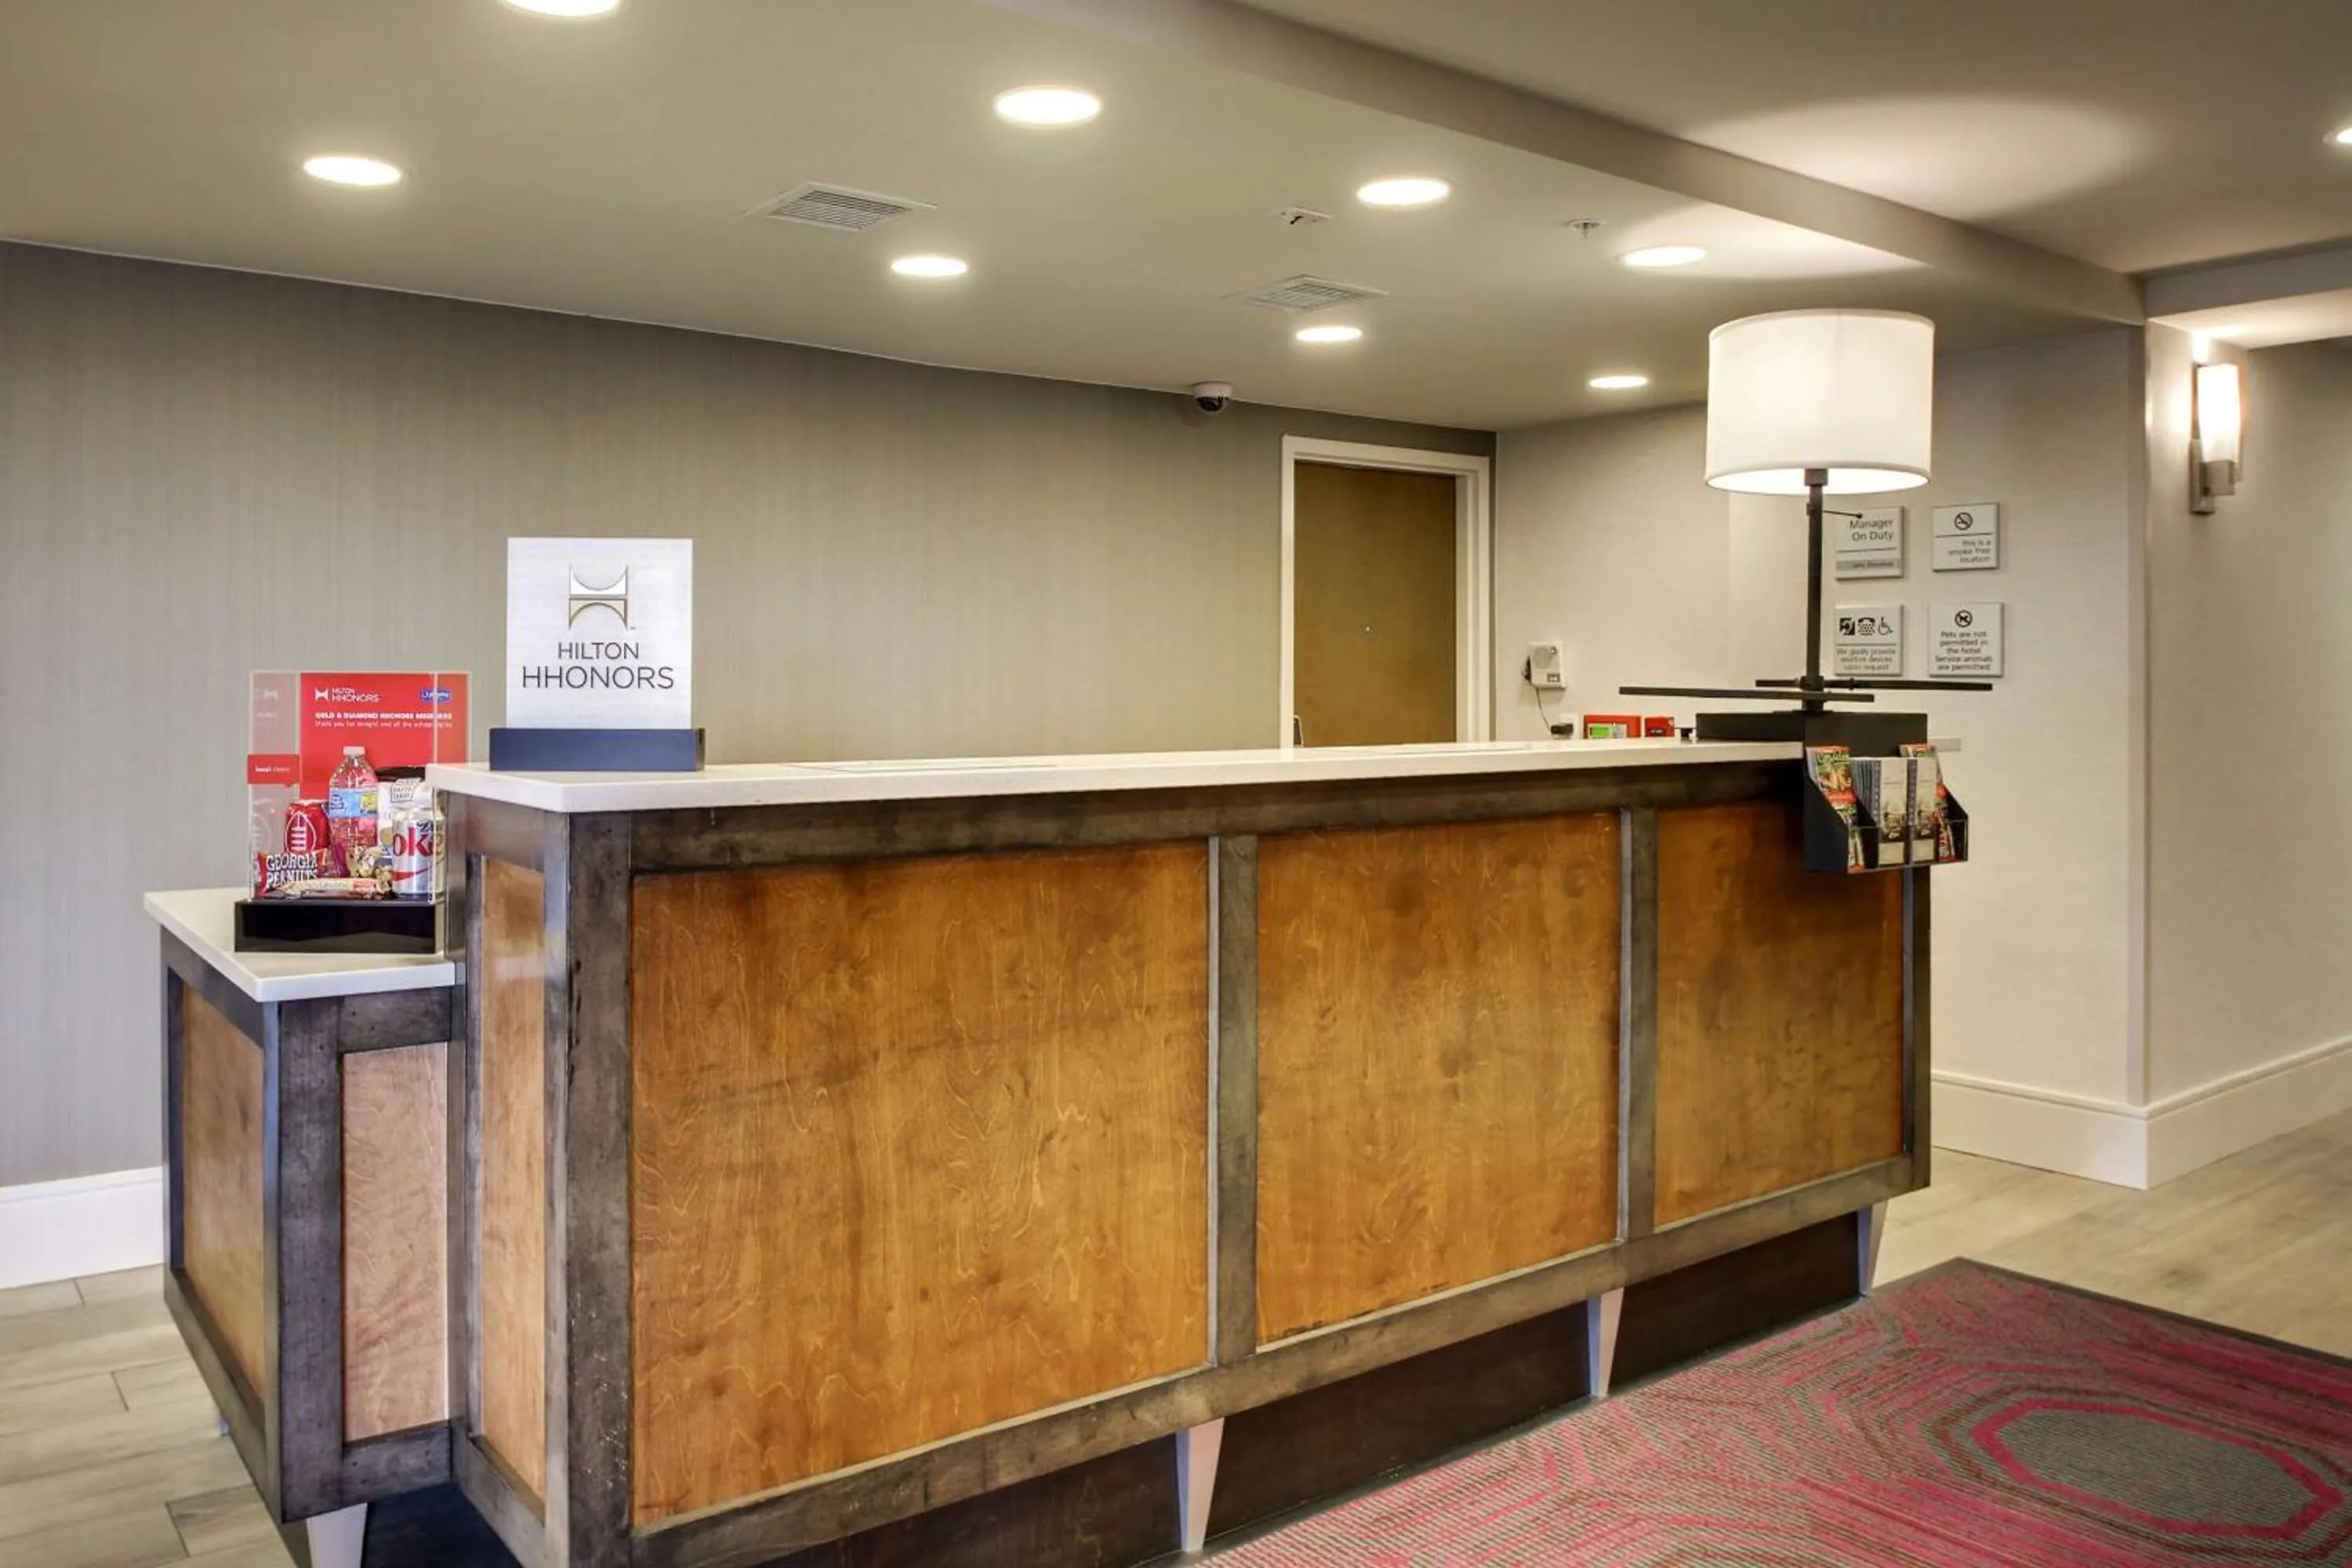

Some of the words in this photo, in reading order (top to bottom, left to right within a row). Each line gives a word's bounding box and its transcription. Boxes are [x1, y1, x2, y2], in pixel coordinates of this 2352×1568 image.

[1849, 519, 1893, 531] Manager
[1851, 532, 1867, 542] On
[1869, 531, 1893, 542] Duty
[557, 642, 639, 659] HILTON
[1939, 639, 1978, 648] permitted
[522, 666, 674, 689] HHONORS
[266, 852, 318, 871] GEORGIA
[266, 869, 318, 890] PEANUTS
